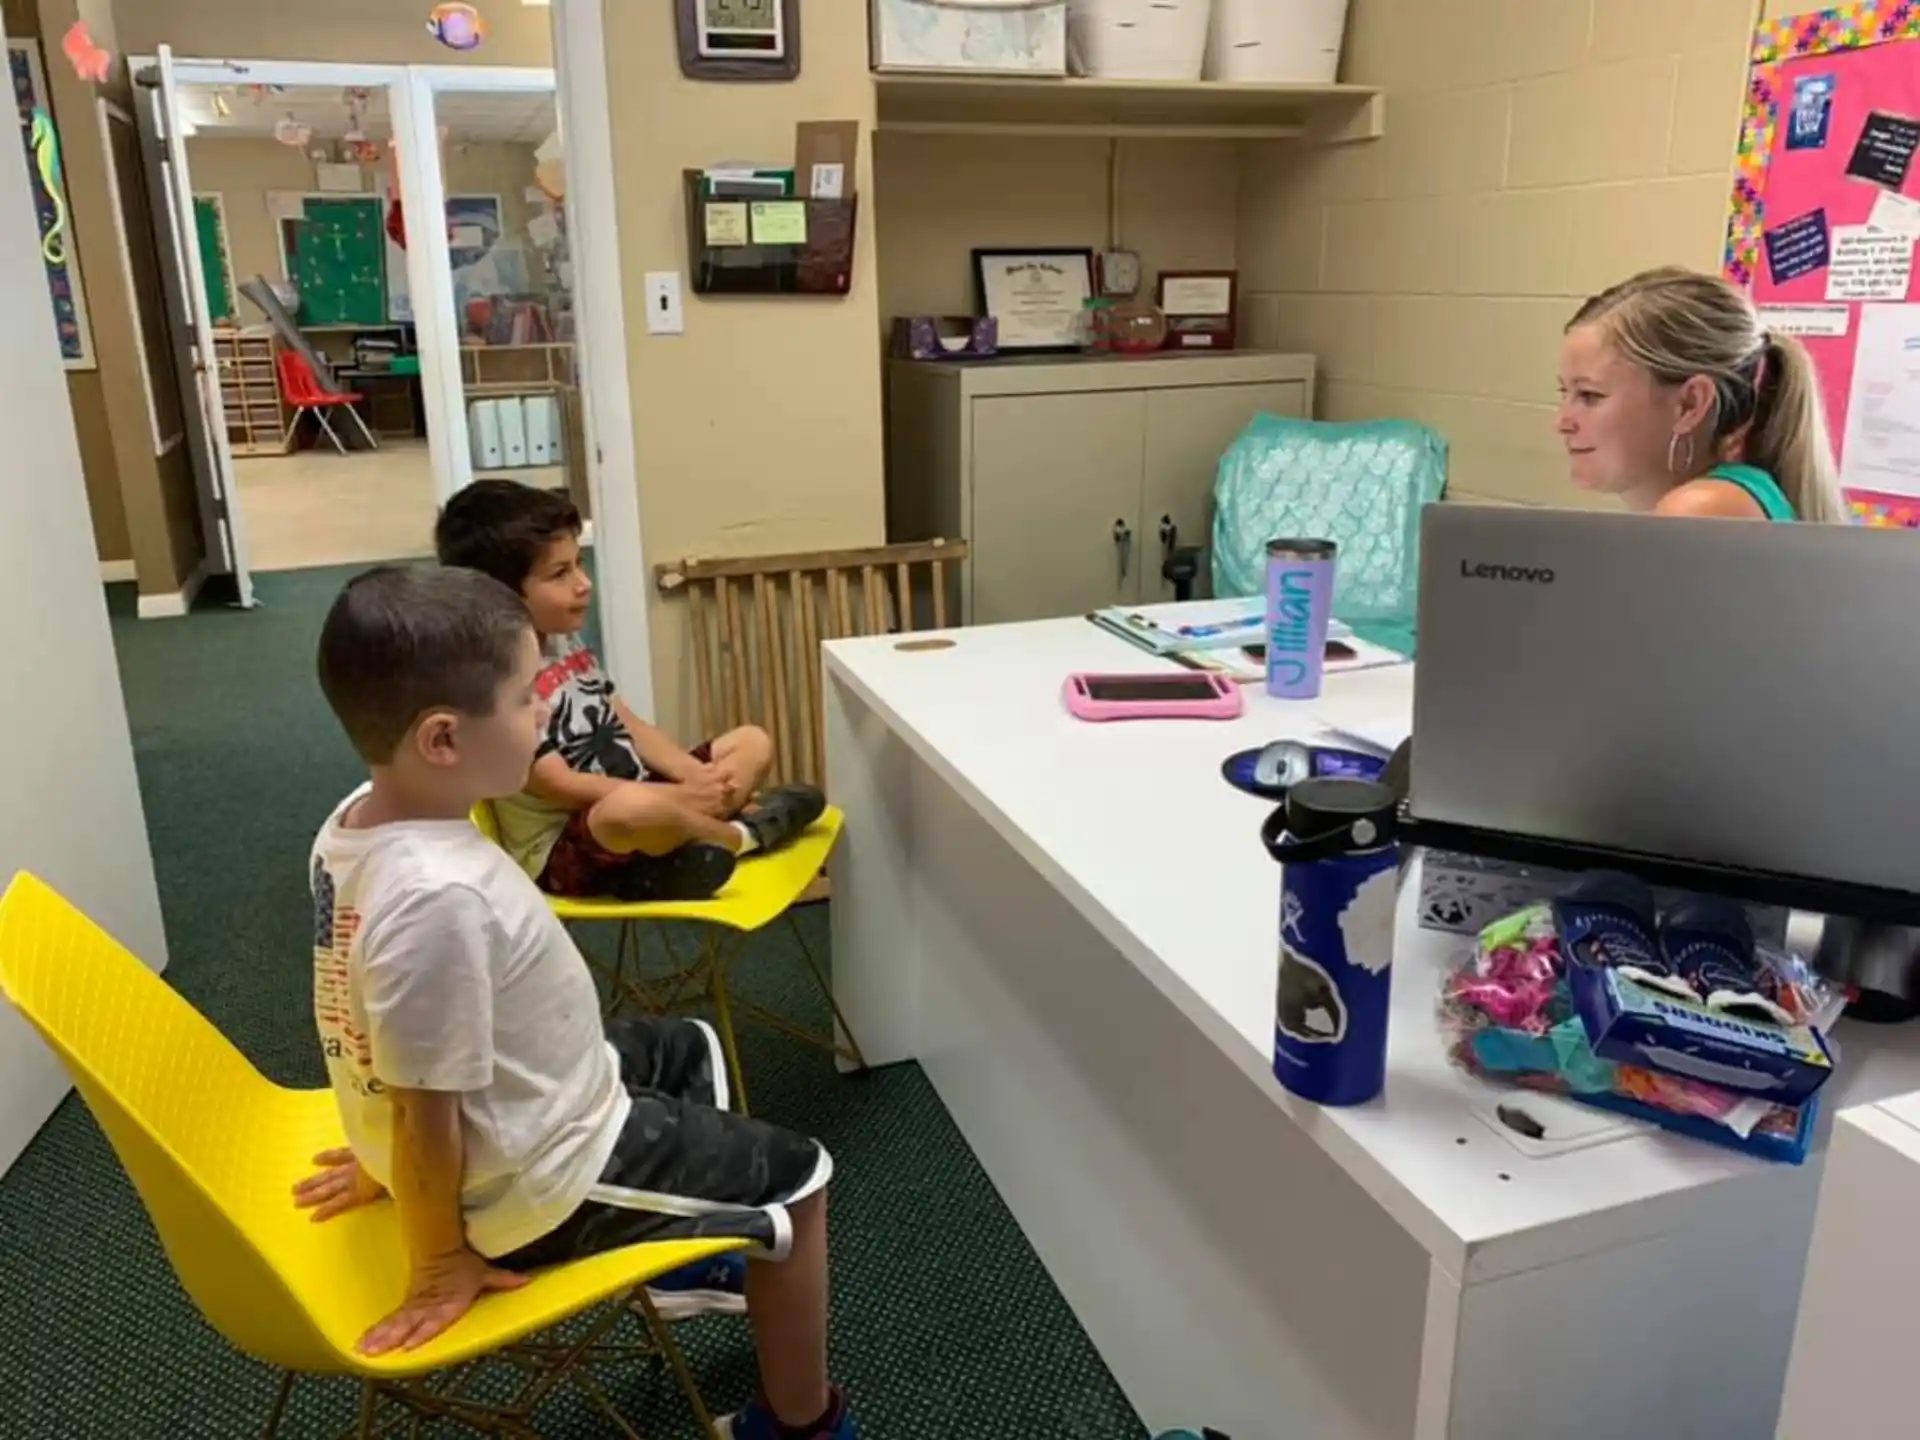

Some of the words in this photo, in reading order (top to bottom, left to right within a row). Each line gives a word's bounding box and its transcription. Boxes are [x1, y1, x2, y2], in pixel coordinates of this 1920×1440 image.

[1460, 558, 1555, 584] Lenovo
[1269, 571, 1313, 686] Jillian
[1653, 1000, 1787, 1045] SKIDDERS
